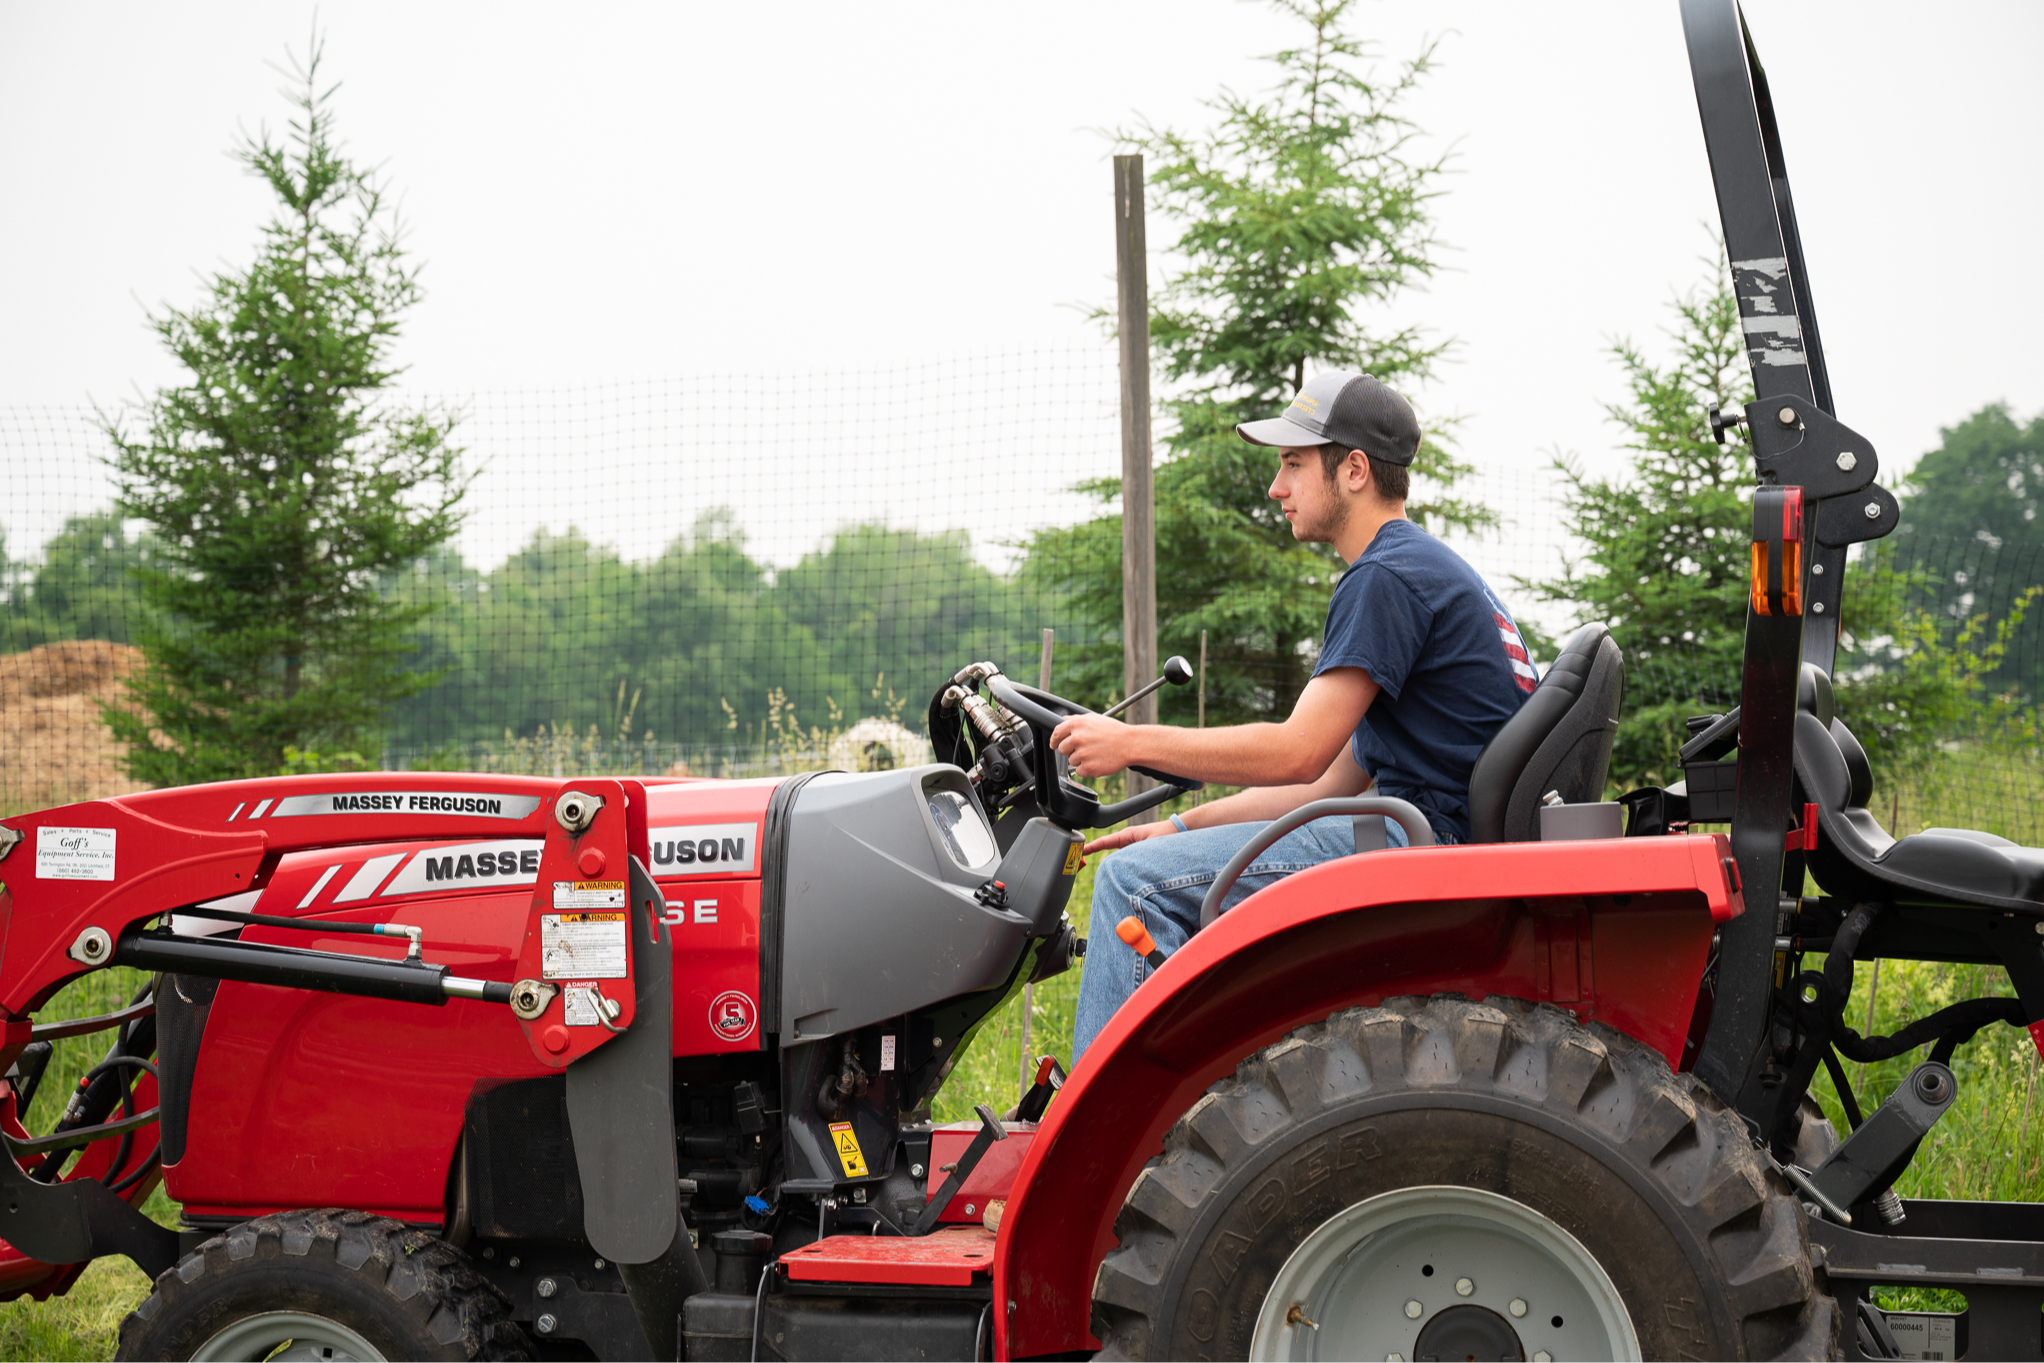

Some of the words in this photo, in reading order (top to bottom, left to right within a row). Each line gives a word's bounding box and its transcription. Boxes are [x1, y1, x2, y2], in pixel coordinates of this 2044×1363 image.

[333, 796, 403, 811] MASSEY
[409, 796, 502, 814] FERGUSON
[92, 829, 111, 838] Service
[60, 837, 89, 850] Goff's
[38, 849, 74, 859] Equipment
[75, 850, 100, 859] Service,
[101, 851, 114, 859] Inc.
[426, 849, 543, 881] MASSE
[648, 838, 746, 865] USON
[585, 881, 622, 890] WARNING
[724, 1002, 740, 1028] 5
[1890, 1323, 1924, 1331] 60000445
